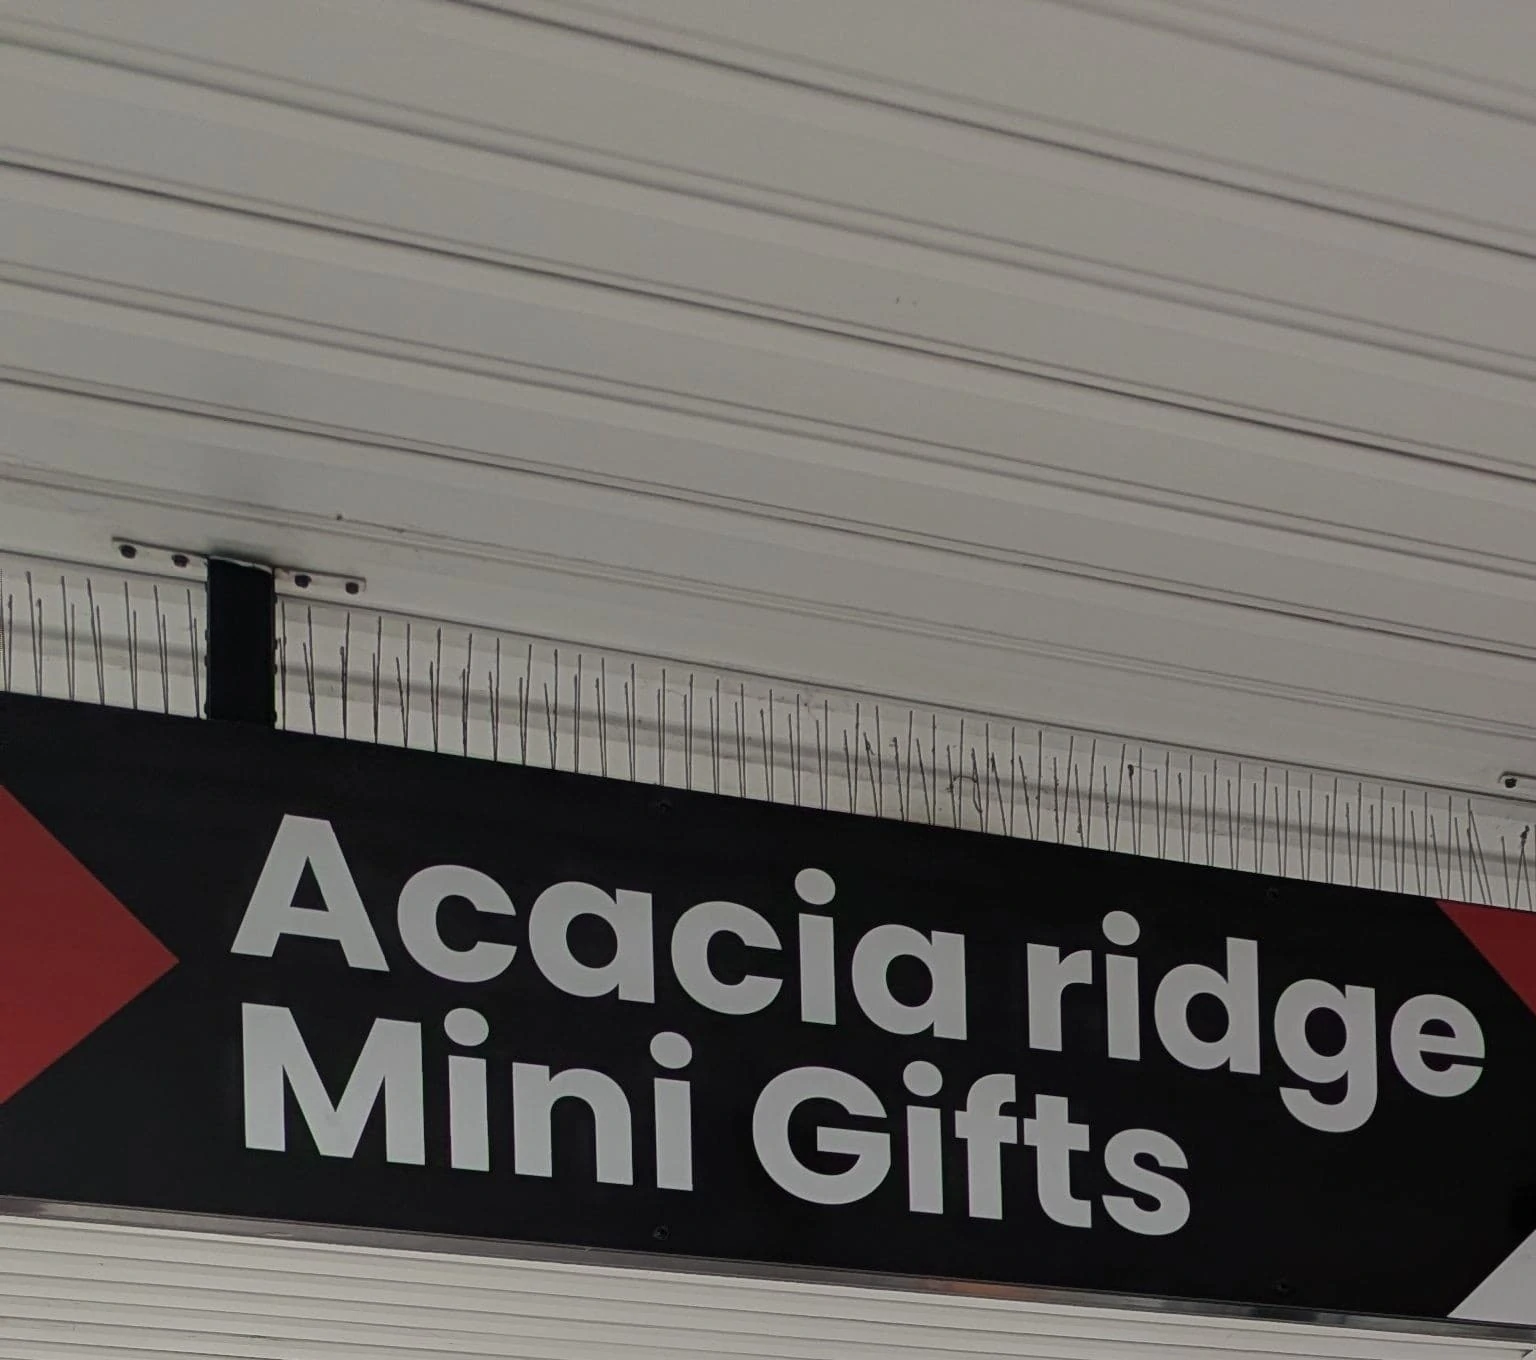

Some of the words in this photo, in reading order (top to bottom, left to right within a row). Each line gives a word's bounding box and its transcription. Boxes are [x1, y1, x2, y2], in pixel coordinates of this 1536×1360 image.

[232, 813, 967, 1040] Acacia
[1028, 911, 1485, 1133] ridge
[242, 1003, 694, 1192] Mini
[752, 1061, 1190, 1236] Gifts
